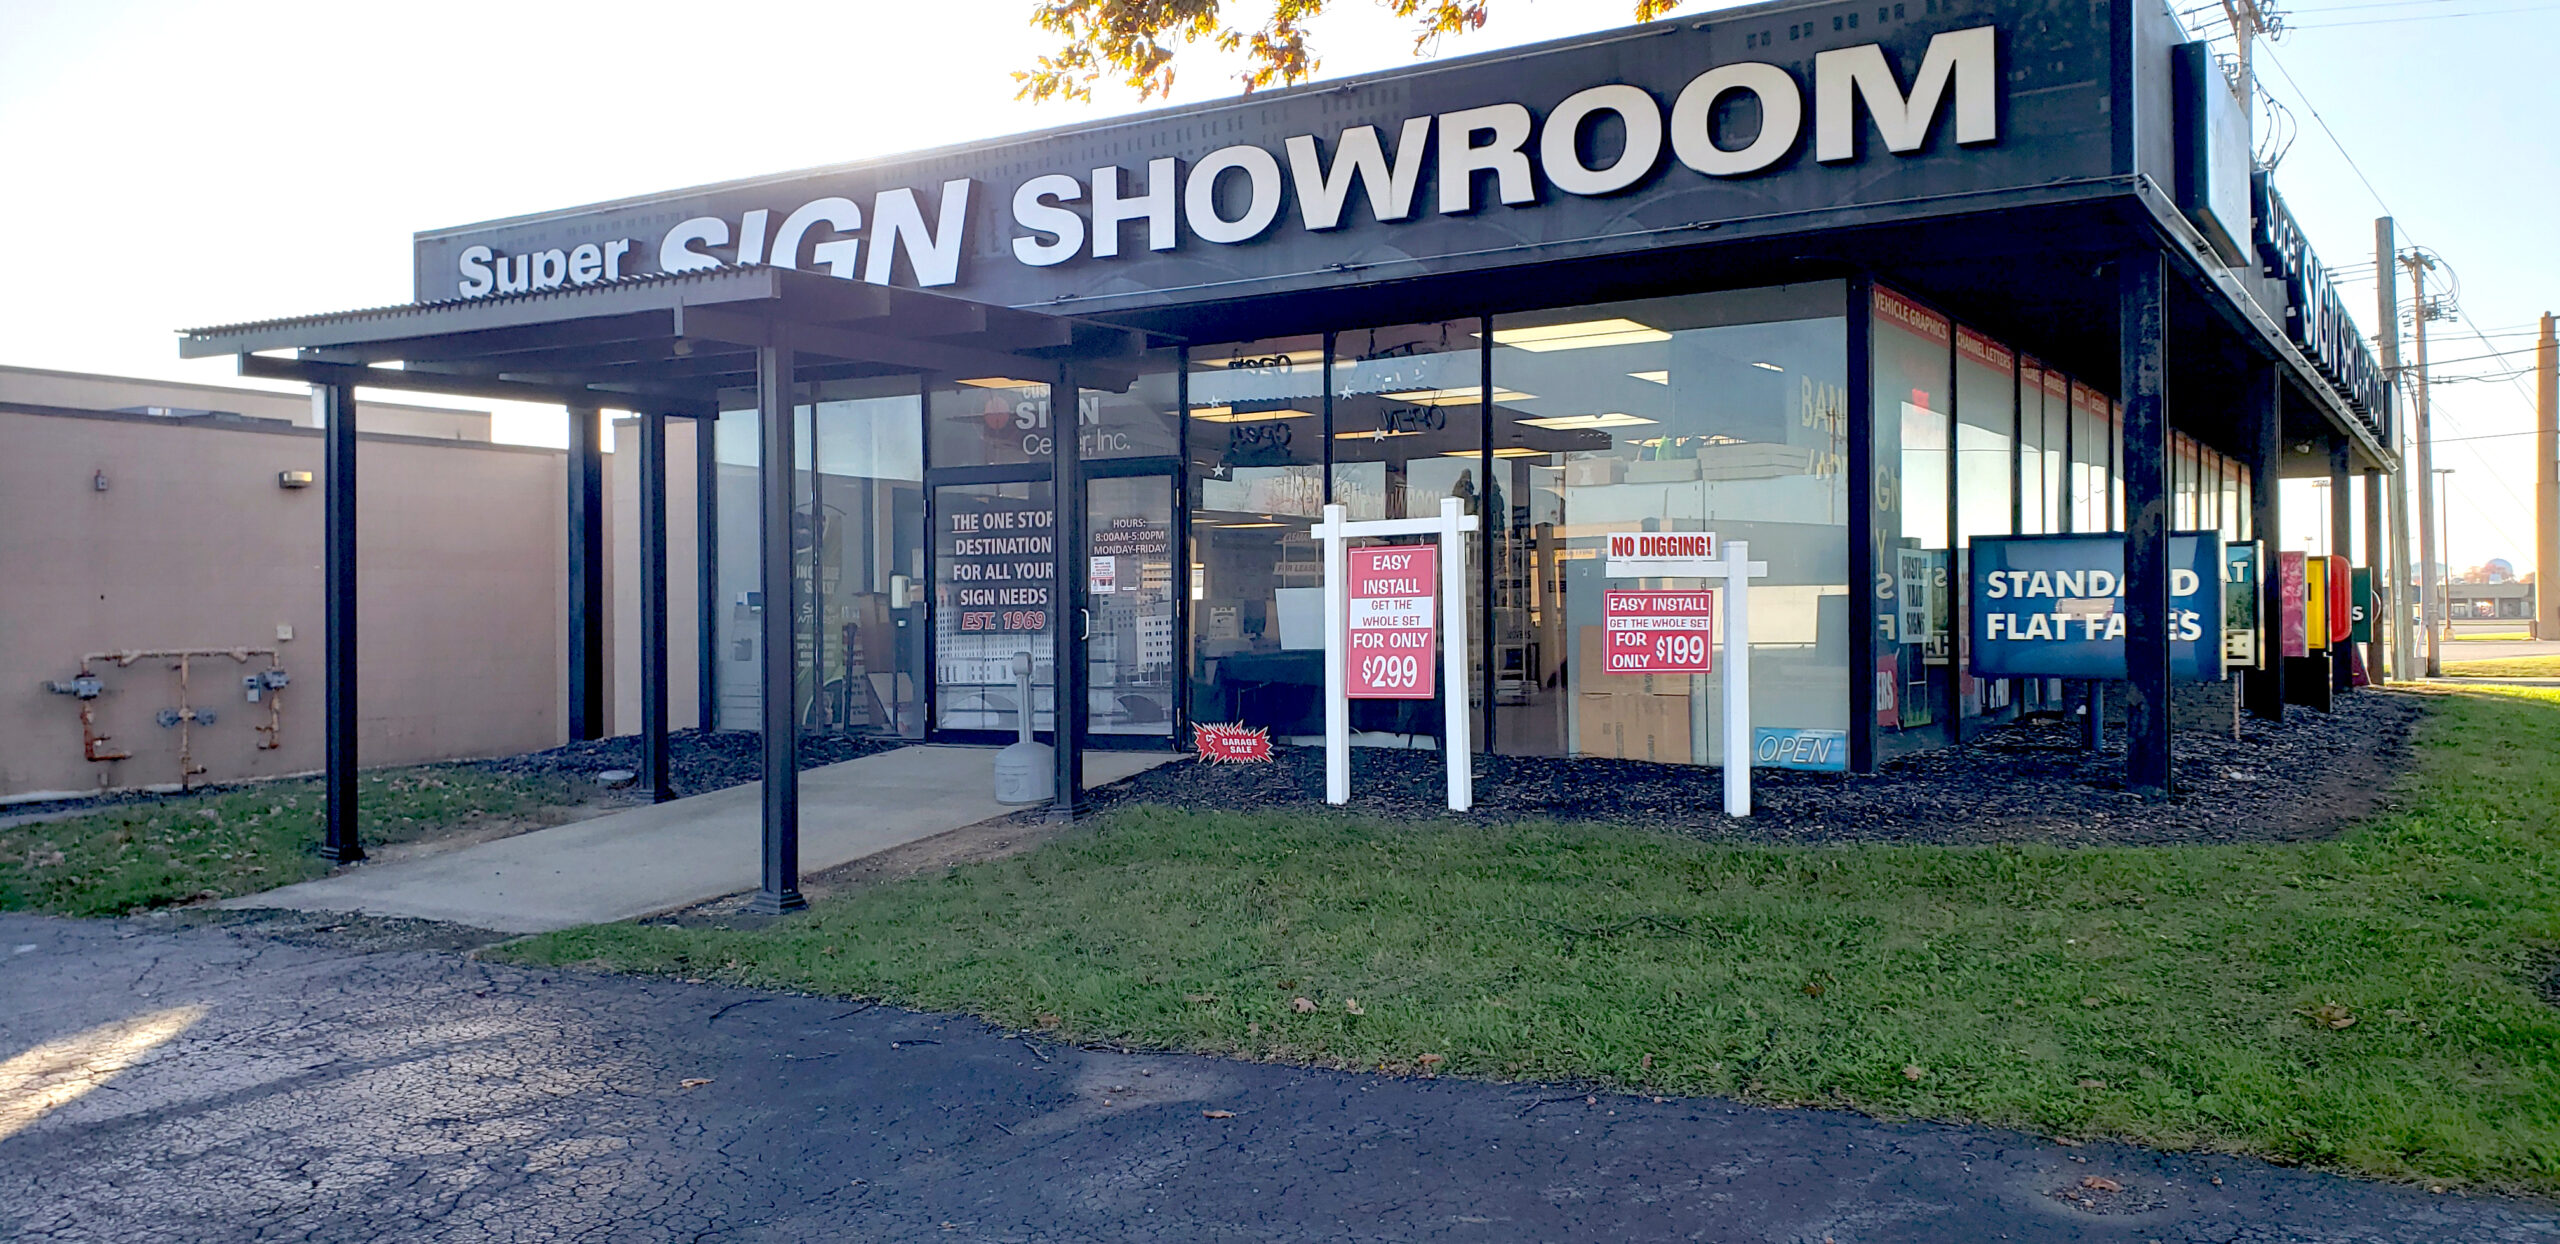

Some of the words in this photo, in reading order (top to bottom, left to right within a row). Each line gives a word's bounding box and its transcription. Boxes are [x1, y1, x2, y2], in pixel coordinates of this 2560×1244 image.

[458, 238, 630, 298] Super
[659, 177, 970, 287] SIGN
[1010, 24, 1997, 268] SHOWROOM
[1874, 289, 1910, 323] VEHICLE
[1909, 308, 1947, 341] GRAPHICS
[1986, 343, 2012, 369] LETTERS
[1015, 397, 1099, 430] SIN
[1097, 428, 1131, 452] Inc.
[952, 514, 979, 533] THE
[982, 512, 1014, 530] ONE
[1113, 518, 1147, 529] HOURS:
[1095, 530, 1165, 542] 8:00AM-5:00PM
[955, 536, 1052, 556] DESTINATION
[1093, 543, 1167, 555] MONDAY-FRIDAY
[1611, 536, 1635, 557] NO
[1639, 536, 1712, 557] DIGGING!
[953, 564, 982, 581] FOR
[984, 563, 1012, 580] ALL
[1013, 562, 1054, 579] YOUR
[1372, 554, 1412, 571] EASY
[1363, 578, 1421, 595] INSTALL
[960, 589, 995, 606] SIGN
[999, 588, 1048, 605] NEEDS
[1371, 600, 1390, 611] GET
[1393, 600, 1412, 610] THE
[1610, 598, 1648, 612] EASY
[1652, 597, 1708, 612] INSTALL
[961, 612, 996, 631] EST.
[1002, 610, 1046, 630] 1969
[1362, 616, 1399, 627] WHOLE
[1402, 616, 1421, 626] SET
[1609, 619, 1628, 628] GET
[1631, 619, 1649, 628] THE
[1651, 618, 1687, 628] WHOLE
[1690, 618, 1708, 628] SET
[1986, 612, 2074, 641] FLAT
[1353, 633, 1384, 649] FOR
[1389, 632, 1429, 649] ONLY
[1615, 632, 1647, 646] FOR
[1655, 635, 1705, 665] $199
[1612, 654, 1651, 668] ONLY
[1361, 655, 1418, 689] $299
[1221, 738, 1259, 746] GARAGE
[1230, 745, 1252, 754] SALE
[1758, 735, 1833, 764] OPEN
